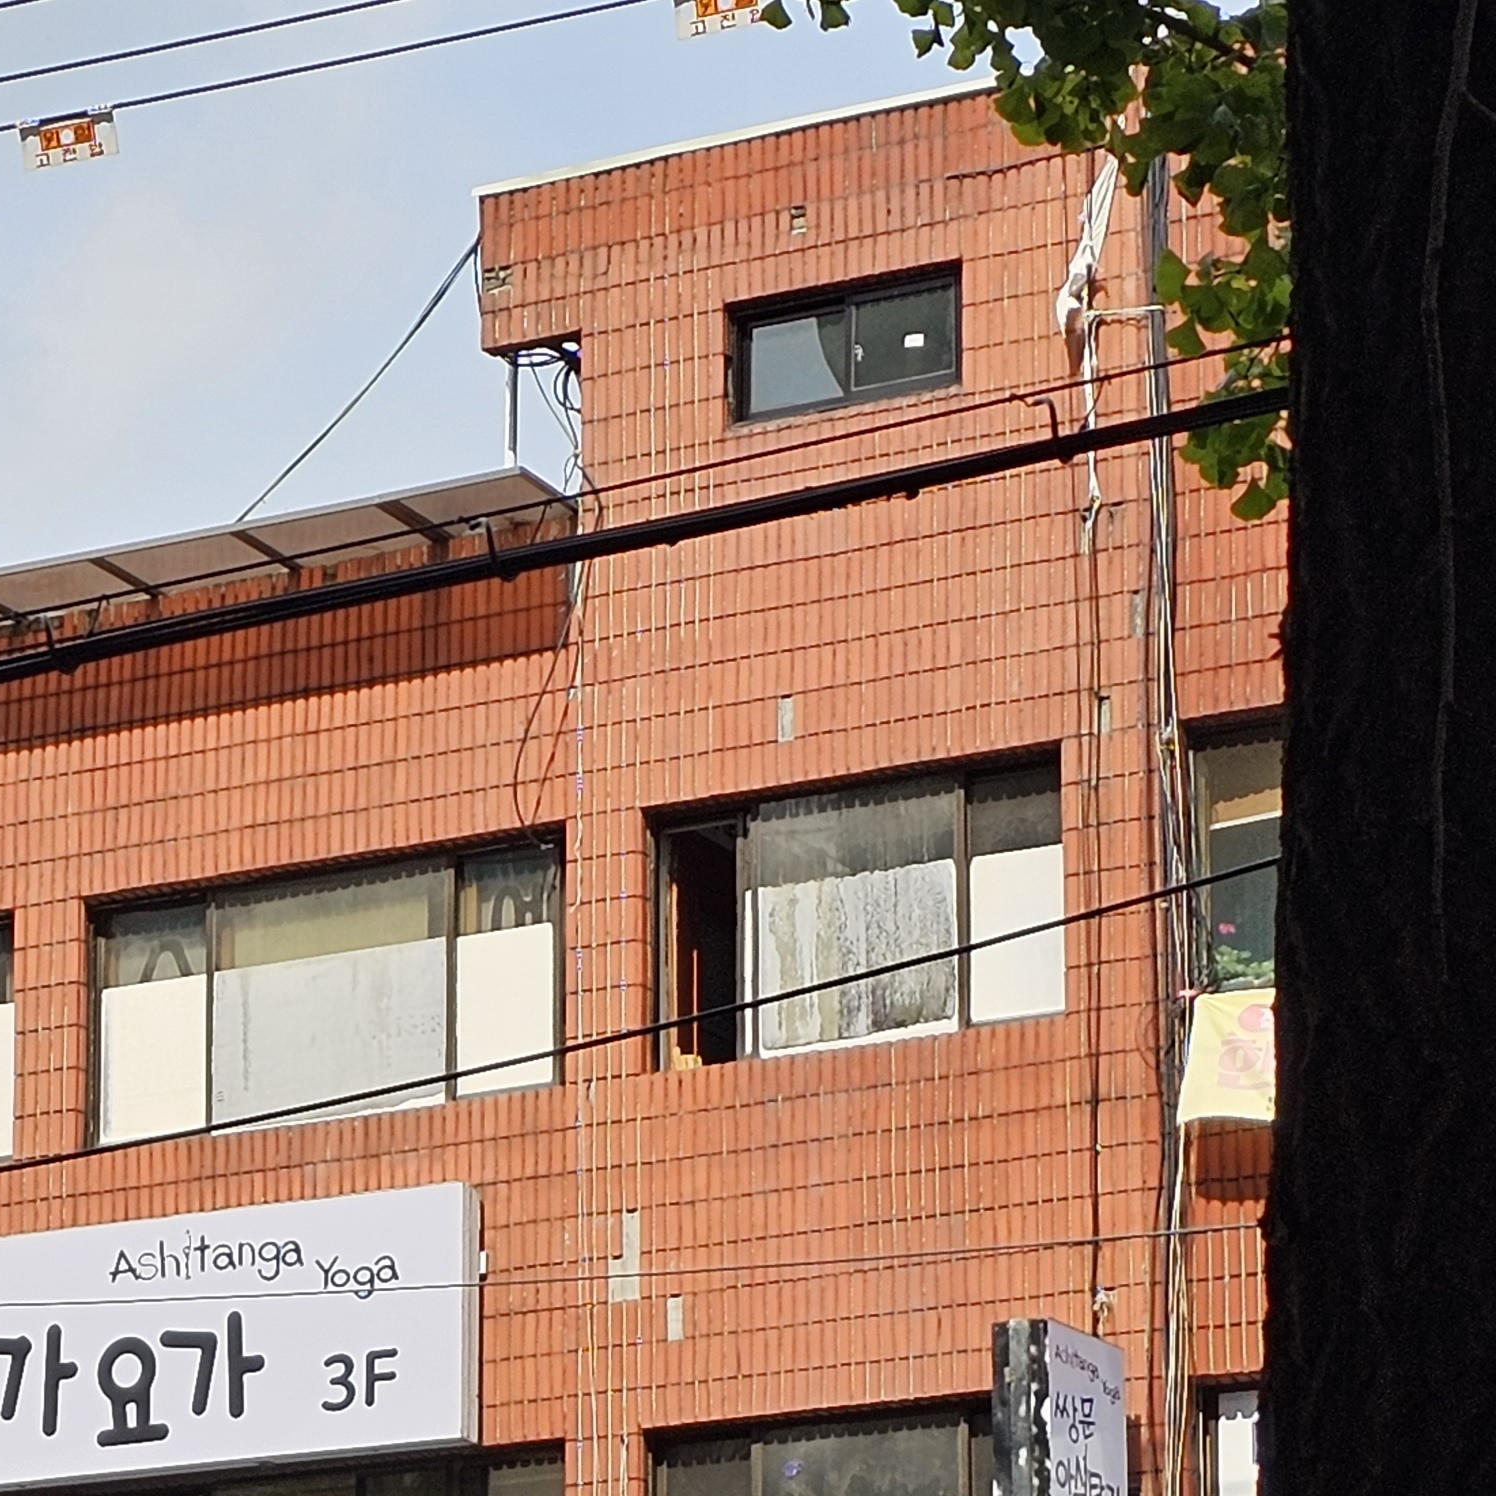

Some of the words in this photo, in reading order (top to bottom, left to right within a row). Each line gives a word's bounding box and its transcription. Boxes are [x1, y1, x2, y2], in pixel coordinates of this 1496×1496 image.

[314, 1255, 399, 1300] Yoga
[321, 1347, 399, 1412] 3F
[1054, 1391, 1096, 1444] 쌍문
